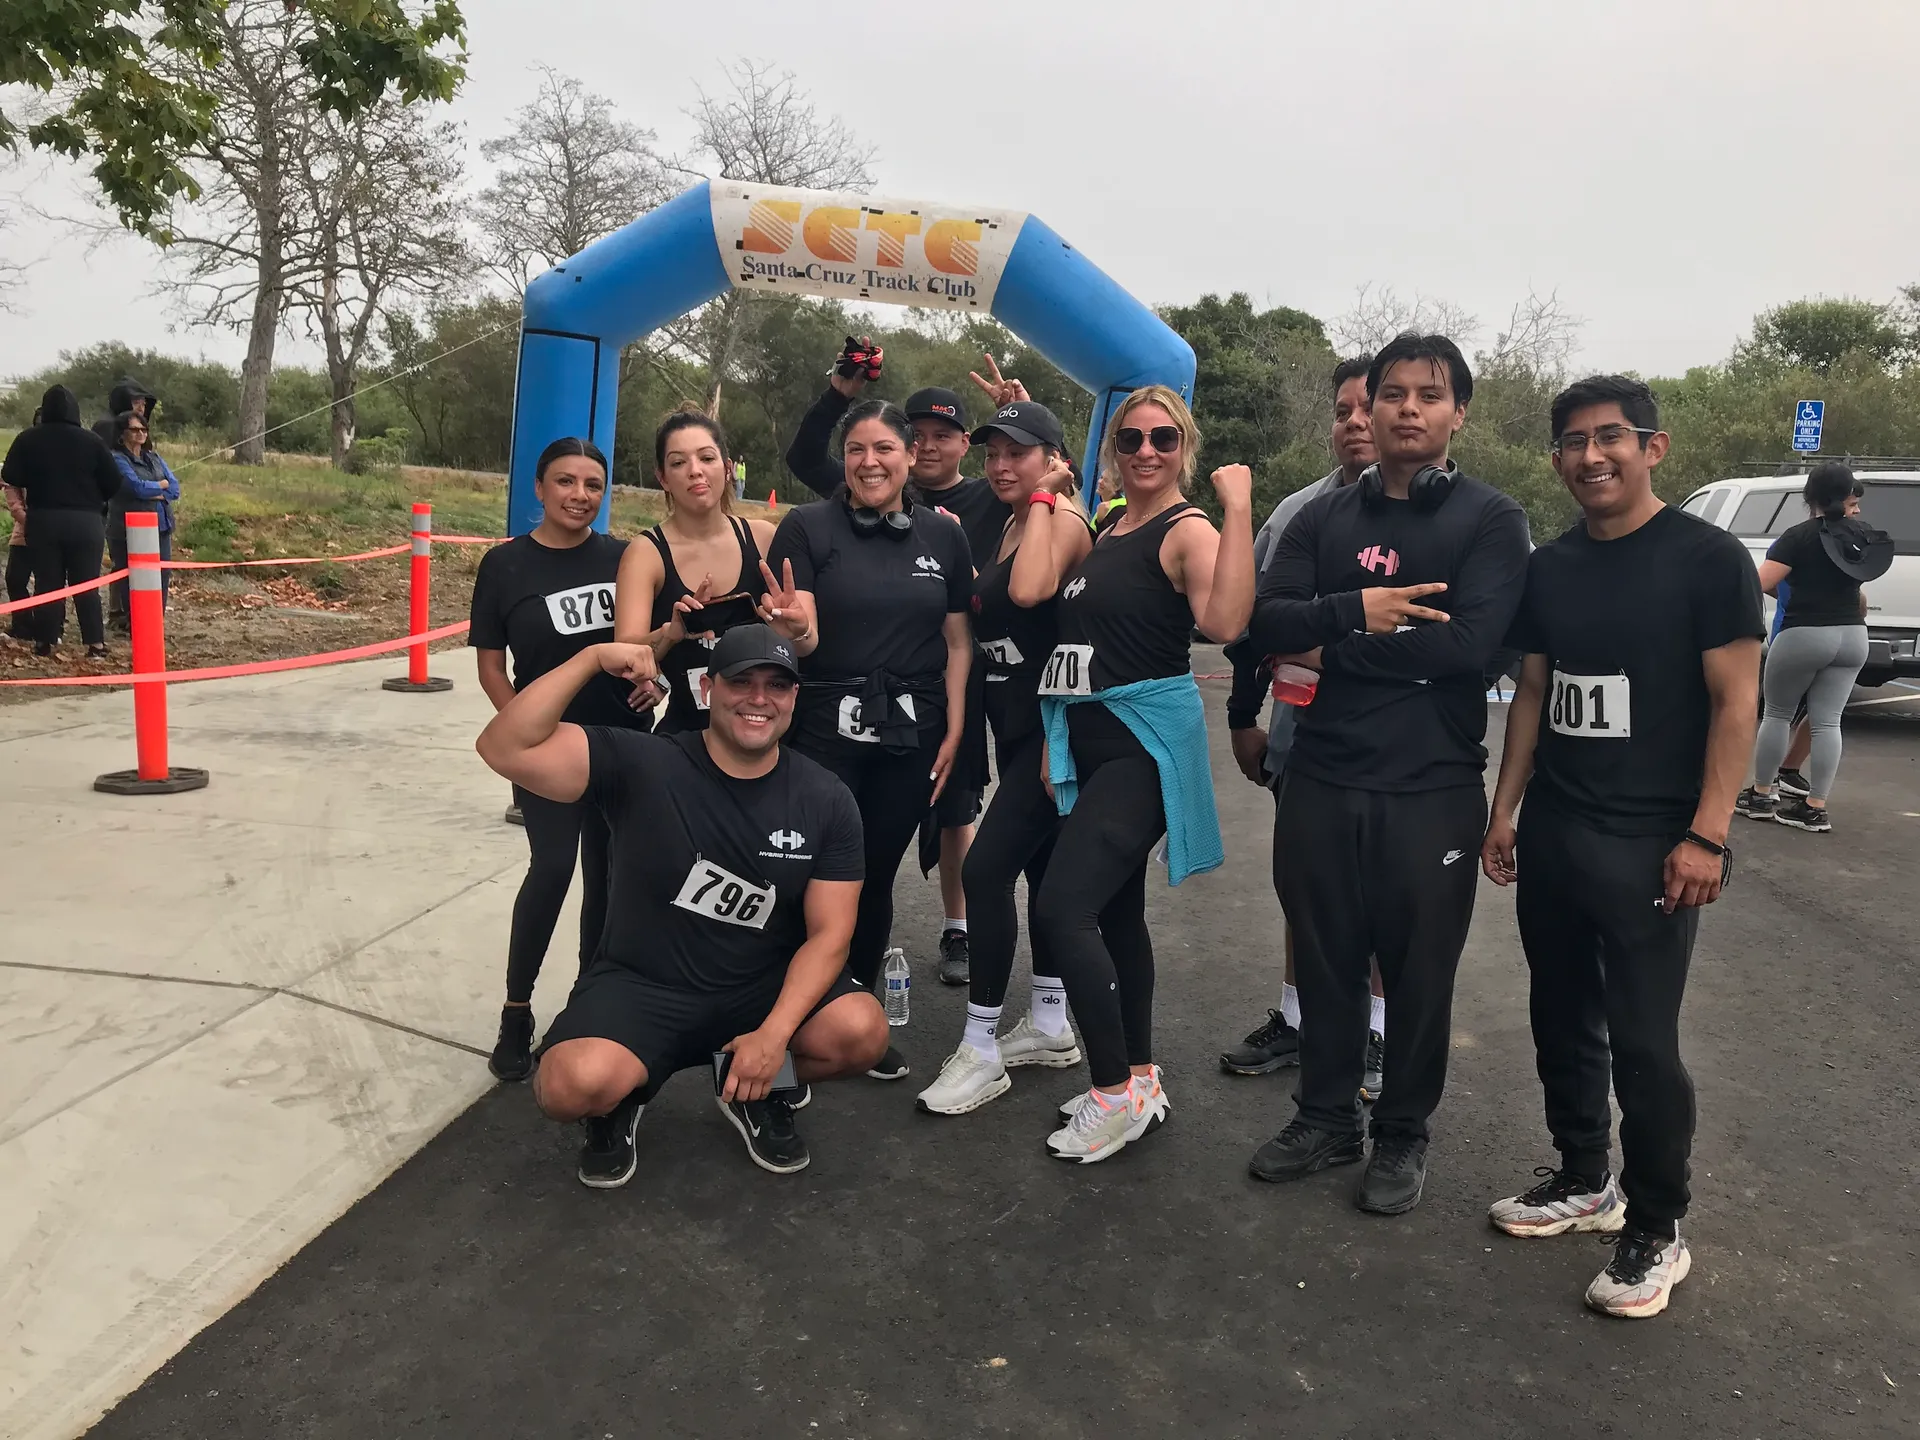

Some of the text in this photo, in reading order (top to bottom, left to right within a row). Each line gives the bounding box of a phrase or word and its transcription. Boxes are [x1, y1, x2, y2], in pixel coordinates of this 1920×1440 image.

[743, 199, 983, 276] SCTC
[743, 255, 976, 298] Santa Cruz Track Club
[998, 406, 1019, 418] alo
[1796, 419, 1821, 428] PARKING
[1800, 427, 1815, 435] ONLY
[559, 589, 615, 628] 879
[1045, 651, 1079, 690] 870
[1553, 680, 1609, 730] 801
[690, 868, 766, 922] 796
[1042, 994, 1060, 1005] alo
